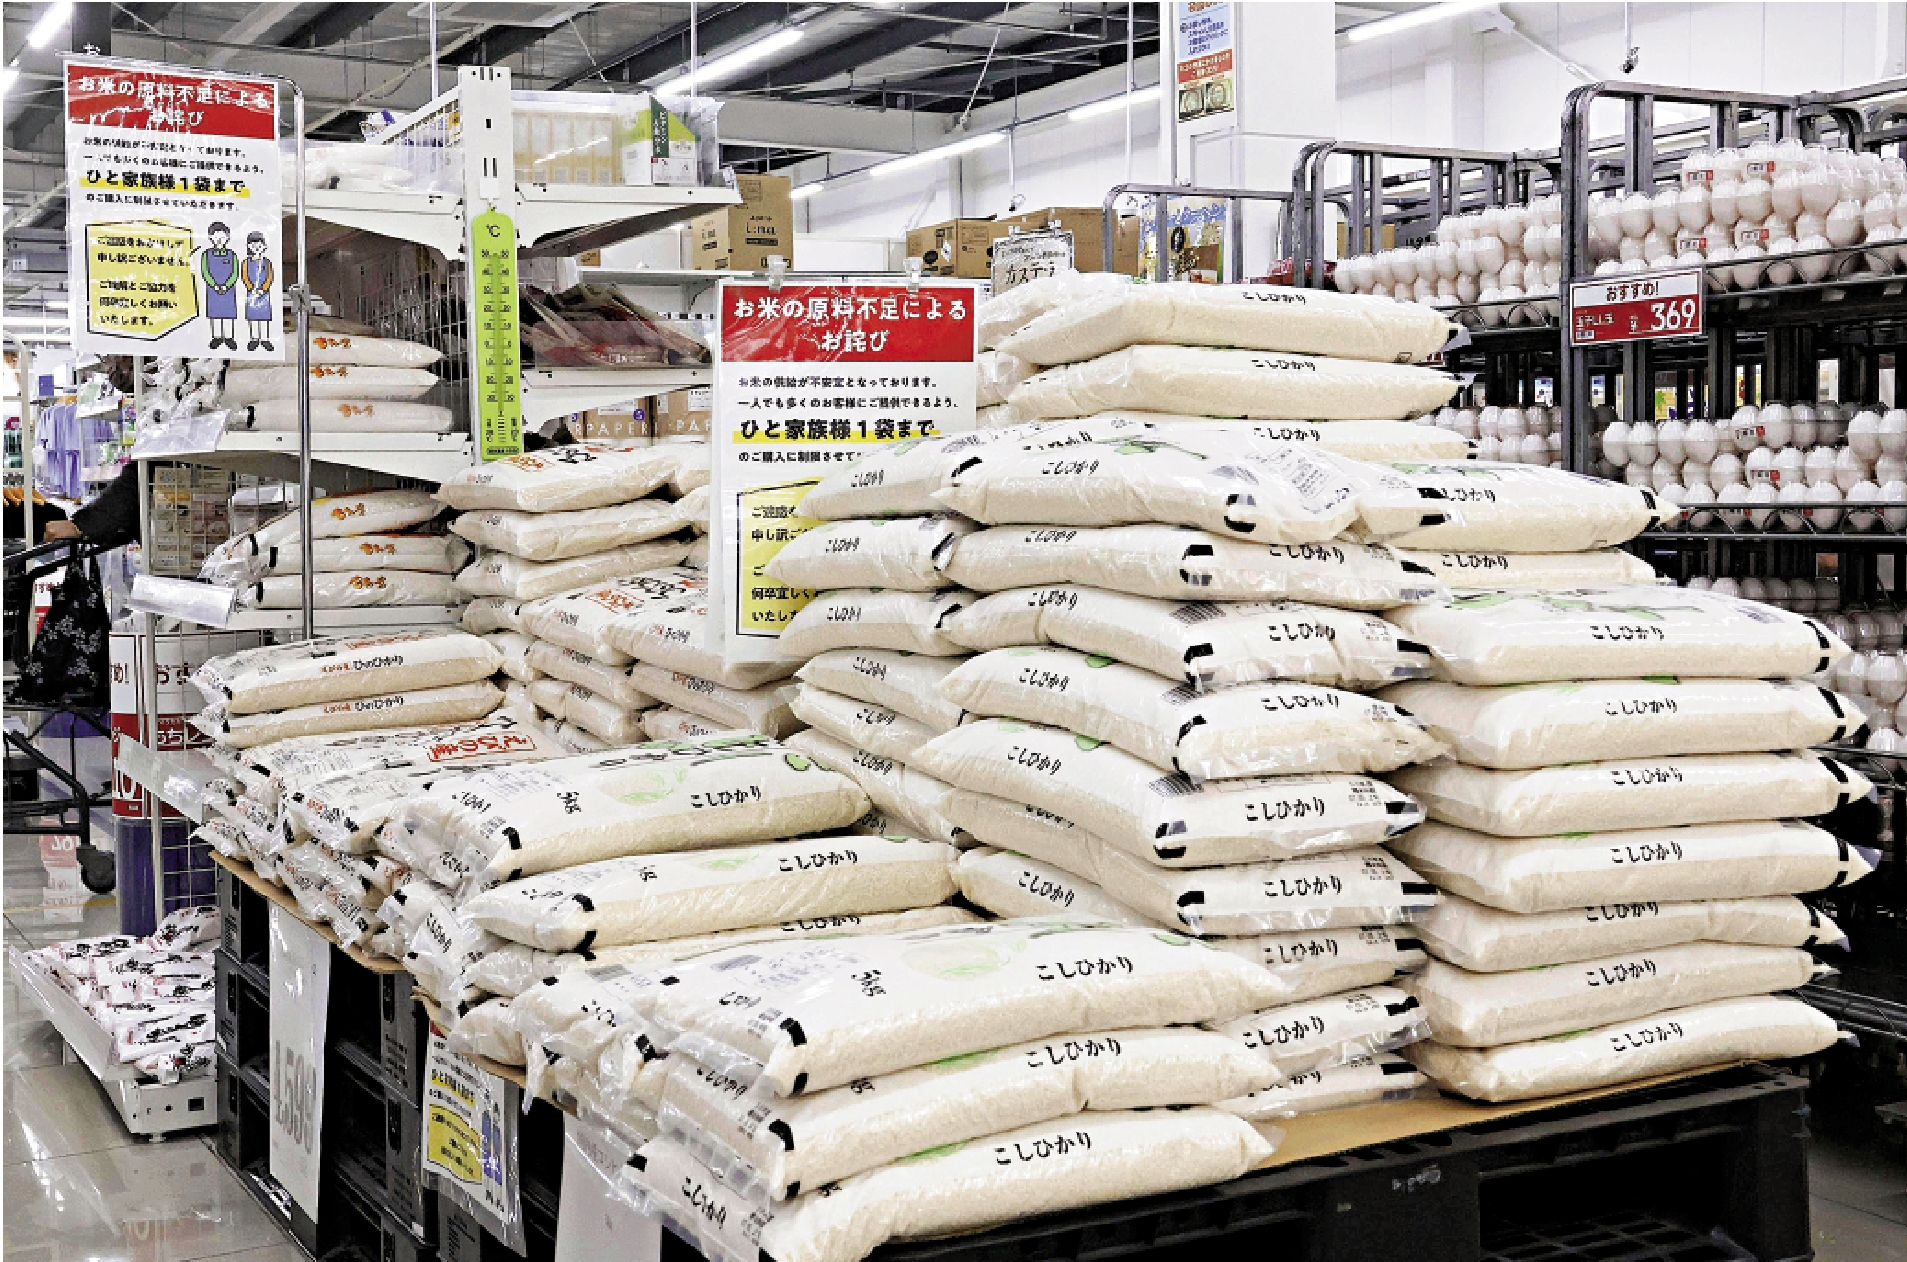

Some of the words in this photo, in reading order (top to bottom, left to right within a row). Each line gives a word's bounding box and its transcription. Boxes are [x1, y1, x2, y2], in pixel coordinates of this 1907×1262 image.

[1243, 291, 1306, 304] こしひかり
[1606, 280, 1660, 302] おすすめ!
[734, 298, 967, 321] お米の原料不足による
[1650, 298, 1697, 331] 369
[820, 329, 890, 352] お詫び
[1252, 359, 1316, 371] こしひかり
[1254, 427, 1320, 441] こしひかり
[738, 451, 864, 463] のご購入に制限させて
[1270, 544, 1345, 563] こしひかり
[1442, 555, 1508, 569] こしひかり
[1028, 591, 1077, 608] こしひかり
[1269, 623, 1335, 641] こしひかり
[1592, 626, 1664, 639] こしひかり
[1020, 668, 1068, 691] こしひかり
[1607, 698, 1677, 714] こしひかり
[1008, 746, 1061, 773] こしひかり
[1612, 768, 1682, 784] こしひかり
[691, 786, 761, 808] こしひかり
[1247, 797, 1324, 821] こしひかり
[780, 850, 857, 871] こしひかり
[1612, 843, 1682, 863] こしひかり
[1019, 871, 1074, 905] こしひかり
[1265, 876, 1340, 896] こしひかり
[1265, 939, 1337, 964] こしひかり
[1037, 957, 1133, 981] こしひかり
[1587, 959, 1656, 986] こしひかり
[1242, 1015, 1324, 1048] こしひかり
[1610, 1022, 1684, 1052] こしひかり
[1027, 1038, 1121, 1062] こしひかり
[996, 1131, 1091, 1161] こしひかり
